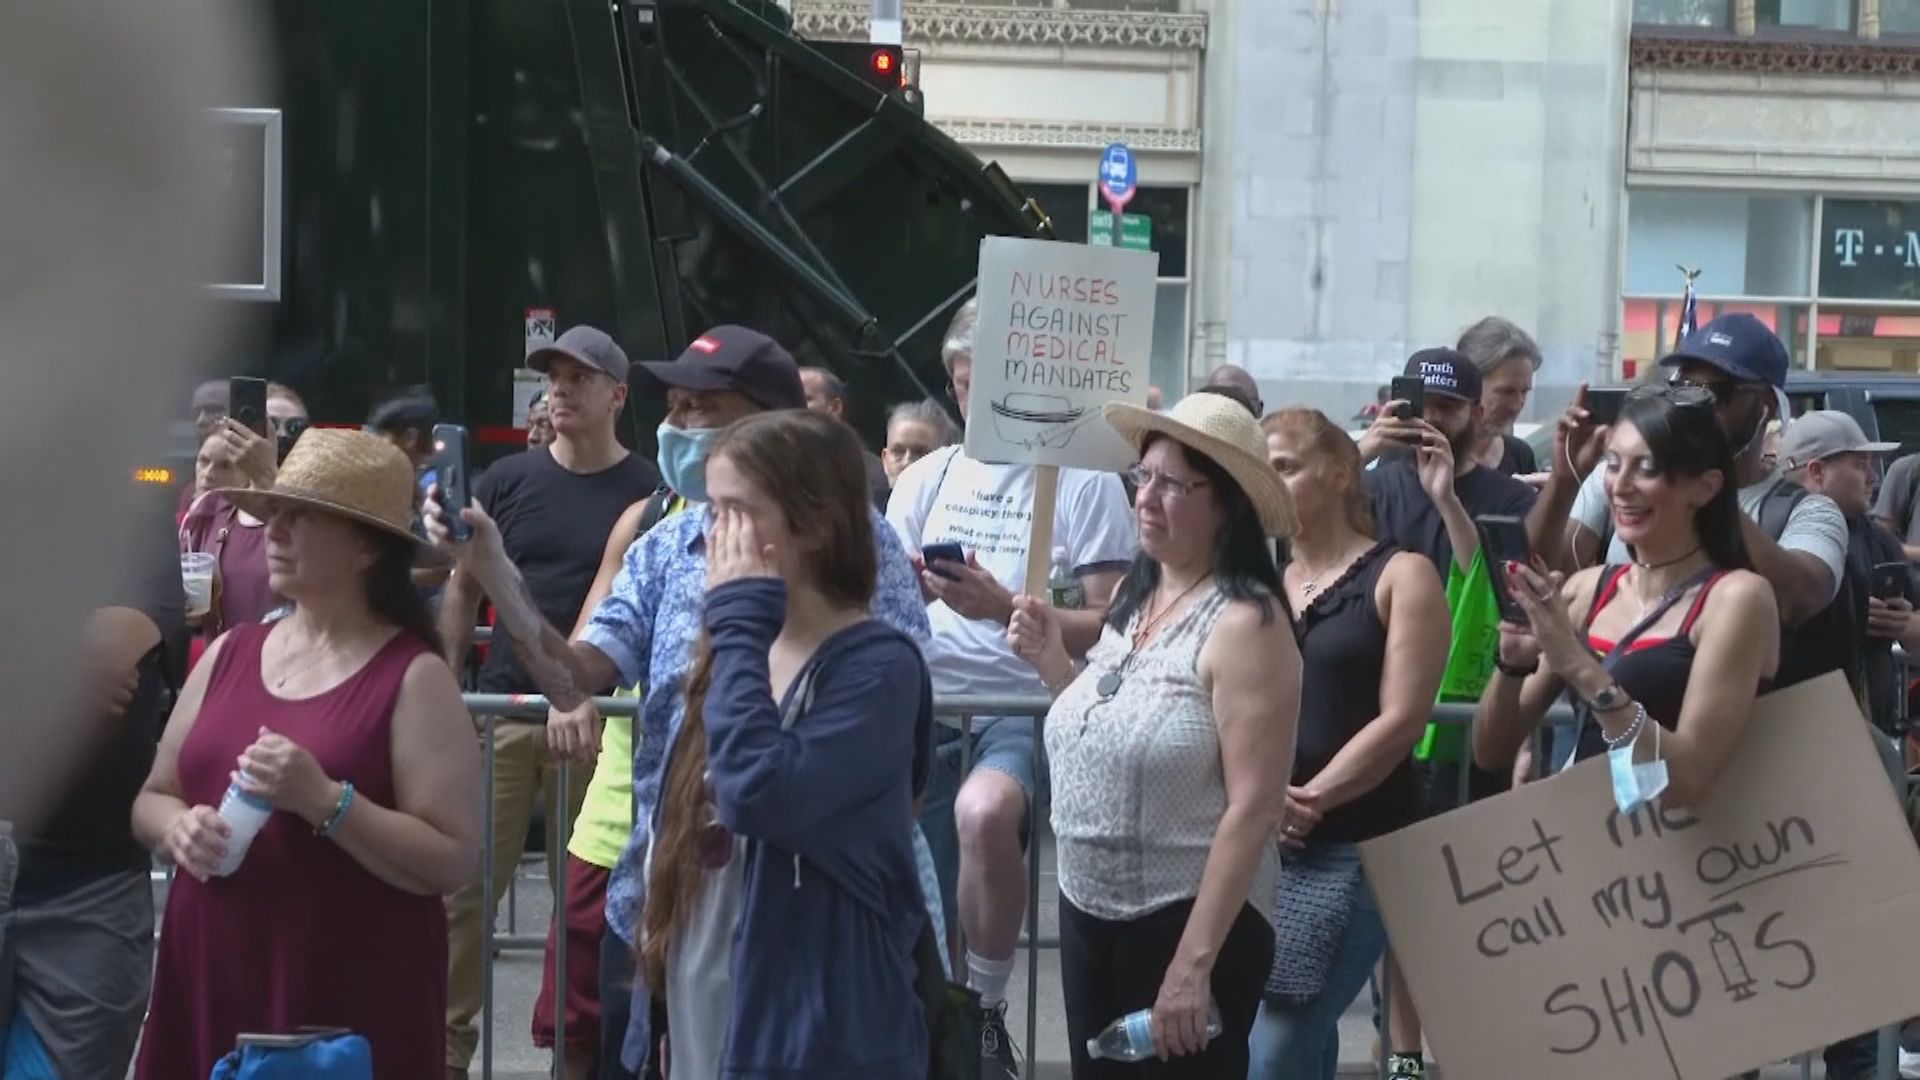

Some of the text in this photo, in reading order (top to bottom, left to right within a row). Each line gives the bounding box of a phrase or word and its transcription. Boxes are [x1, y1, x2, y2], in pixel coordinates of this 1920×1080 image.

[1011, 271, 1119, 305] NURSES
[1010, 300, 1128, 338] AGAINST
[1007, 331, 1125, 366] MEDICAL
[1005, 358, 1132, 393] MANDATES
[1417, 374, 1458, 388] atters
[1420, 361, 1454, 375] Truth
[976, 490, 1004, 504] have
[1441, 817, 1564, 905] Let
[1476, 814, 1816, 958] call my own
